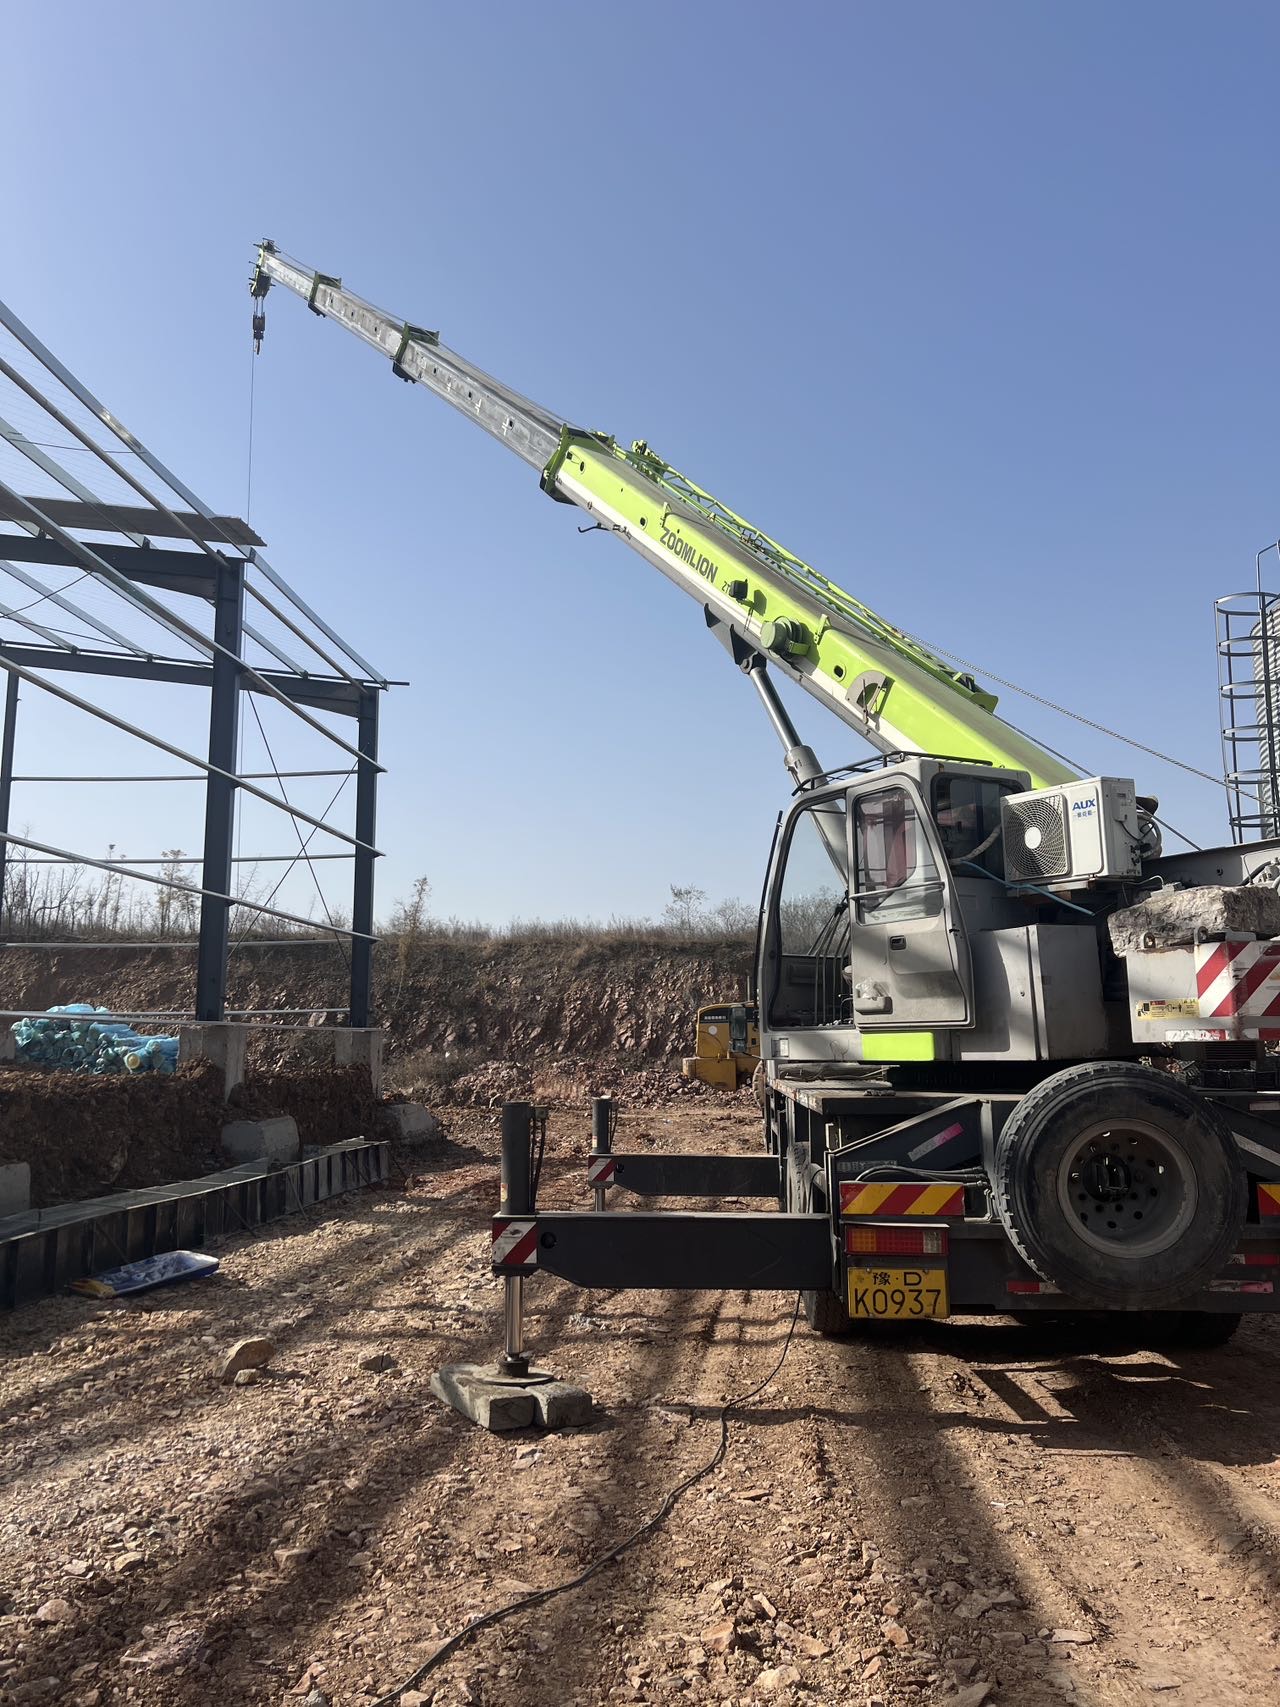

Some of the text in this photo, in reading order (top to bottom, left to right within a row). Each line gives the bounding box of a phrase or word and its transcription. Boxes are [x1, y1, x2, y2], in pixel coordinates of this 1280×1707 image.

[660, 526, 718, 583] ZOOMLION
[1072, 799, 1096, 811] AUX
[854, 1288, 941, 1316] K0937
